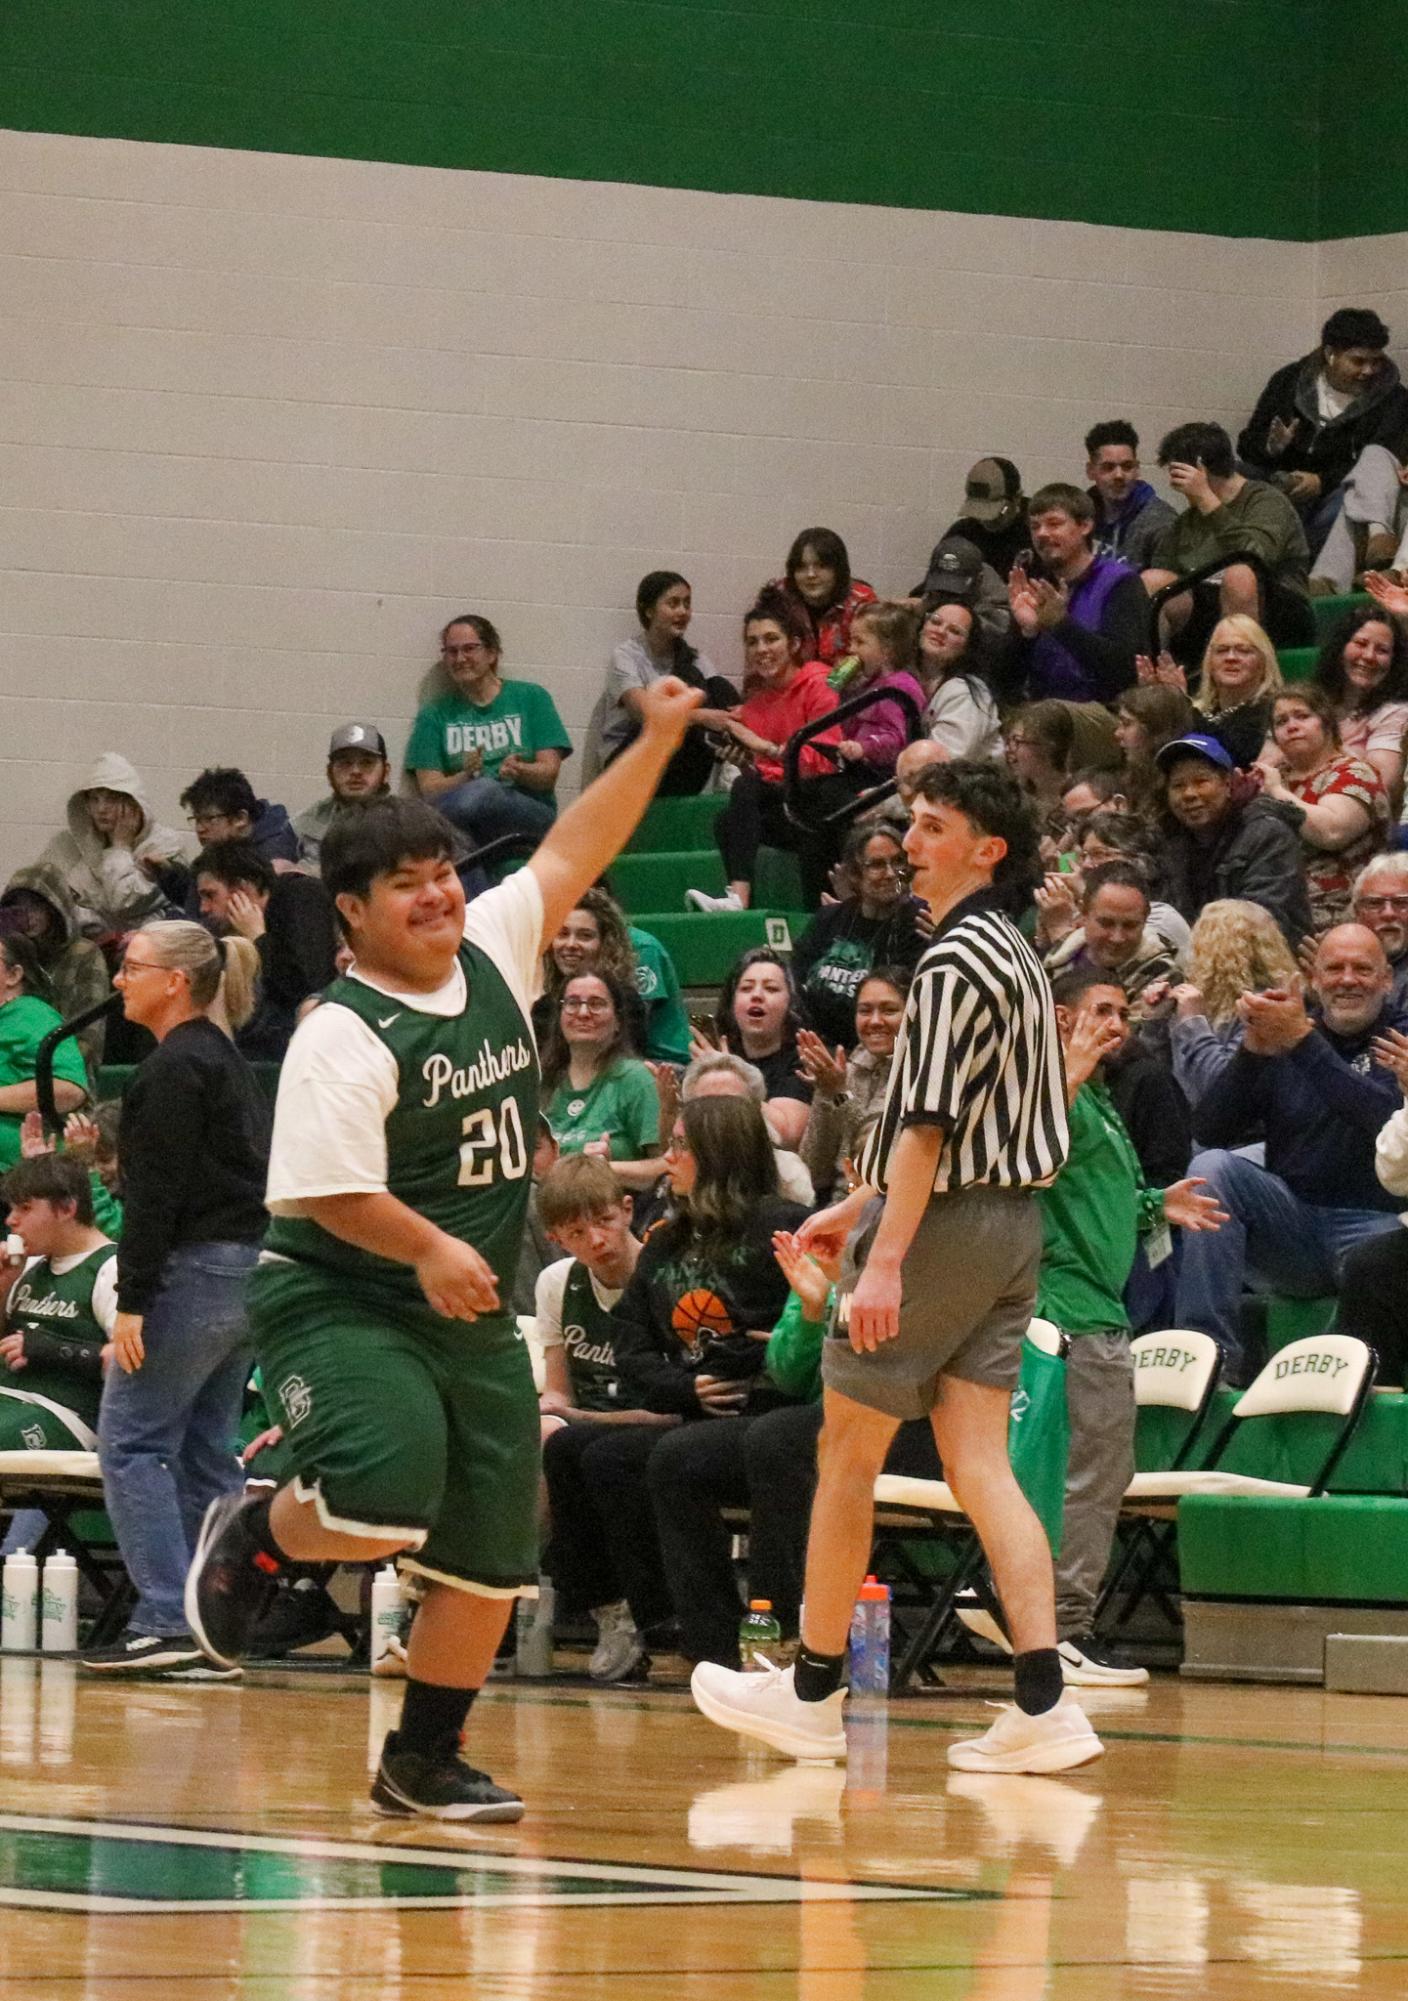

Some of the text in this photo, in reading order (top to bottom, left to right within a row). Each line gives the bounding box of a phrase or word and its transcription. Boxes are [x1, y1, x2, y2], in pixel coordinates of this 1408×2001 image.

[446, 717, 522, 755] DERBY
[422, 1038, 531, 1108] Panthers
[457, 1096, 528, 1186] 20
[1274, 1353, 1349, 1380] DERBY
